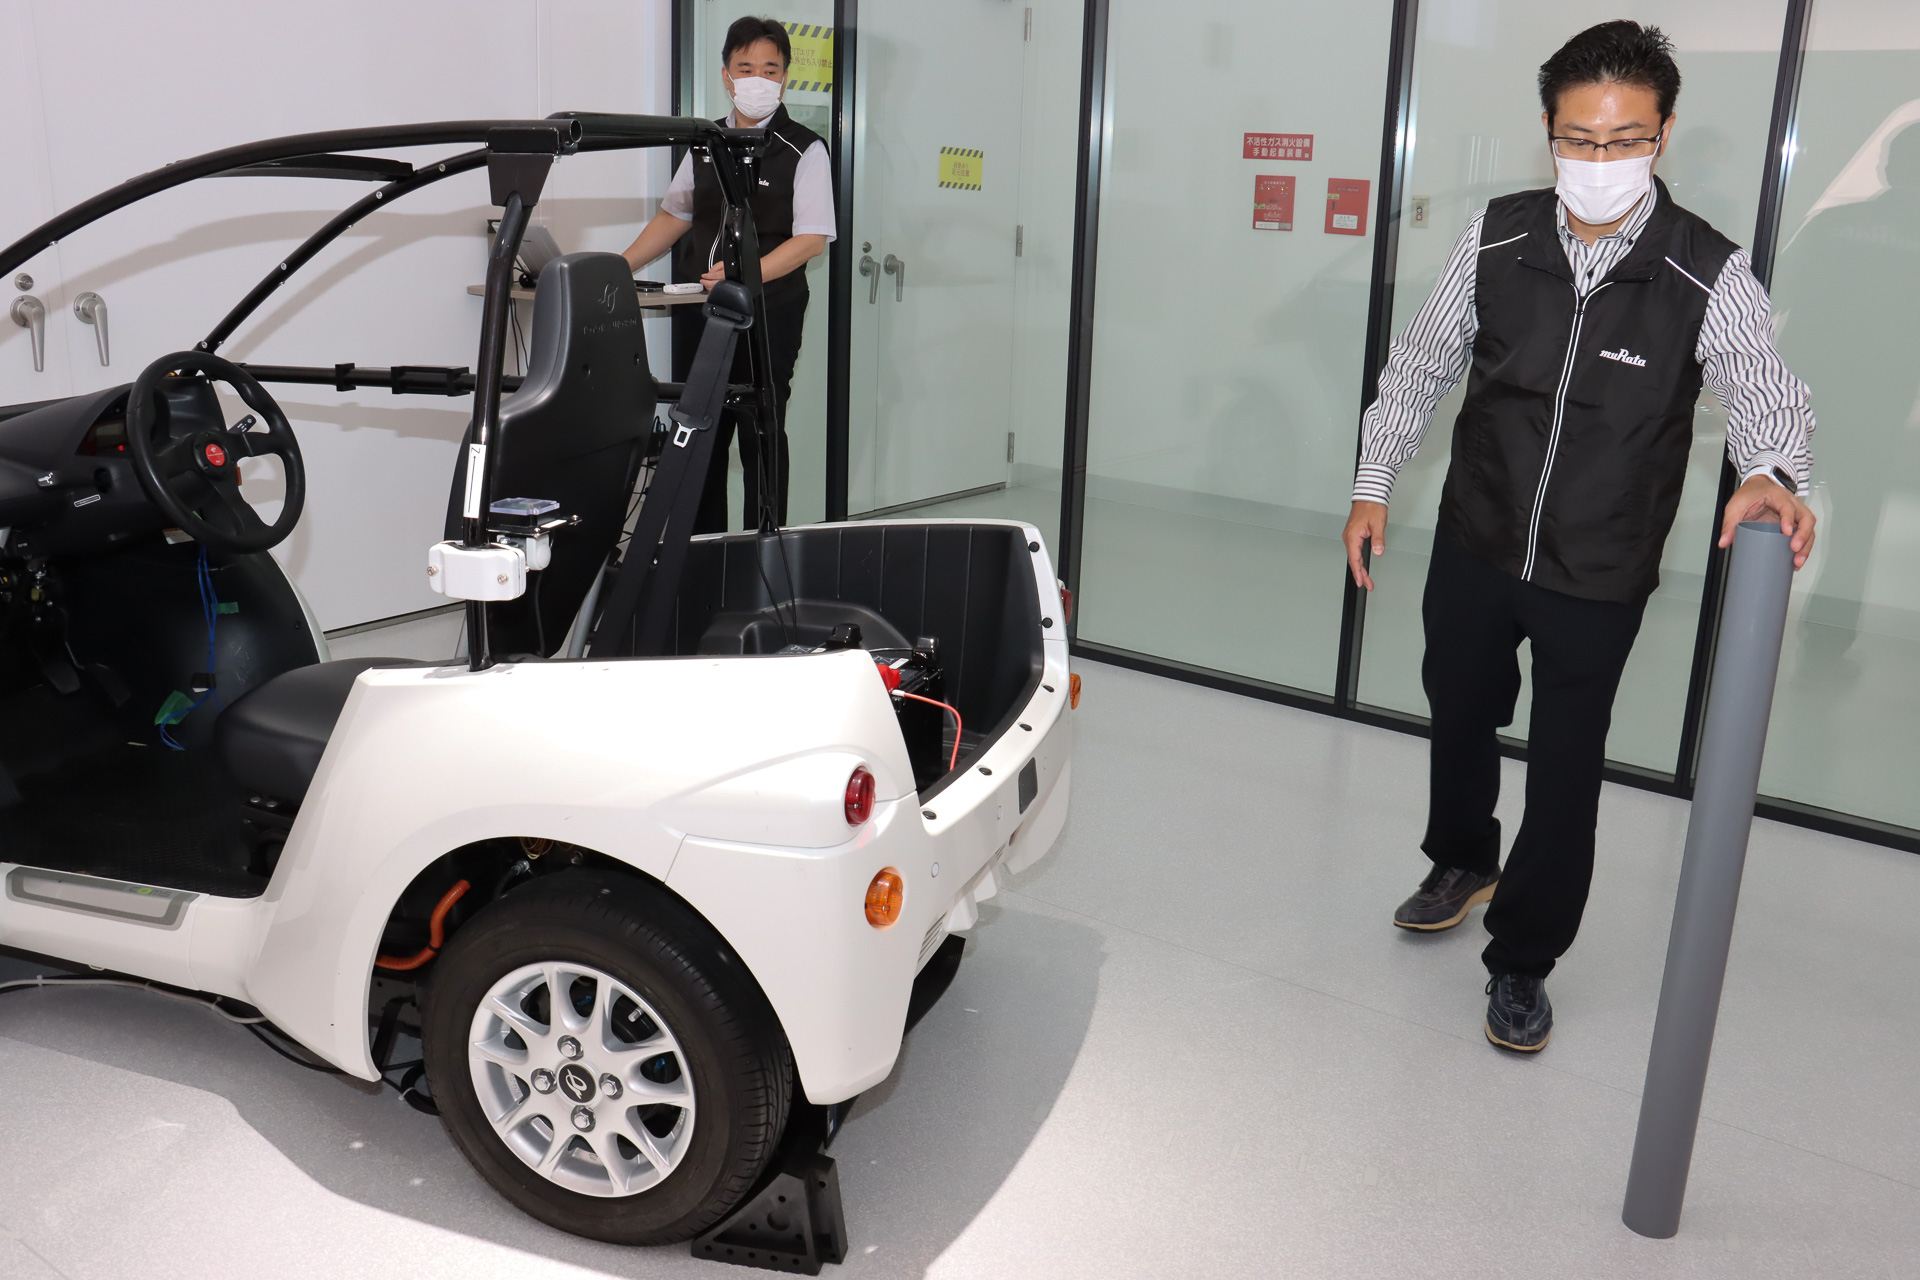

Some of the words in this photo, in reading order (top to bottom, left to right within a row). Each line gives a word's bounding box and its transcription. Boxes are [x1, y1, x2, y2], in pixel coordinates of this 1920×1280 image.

[1246, 136, 1311, 148] 不活性ガス消火設備
[1252, 147, 1302, 158] 手動起動装置
[1599, 348, 1647, 367] muRata
